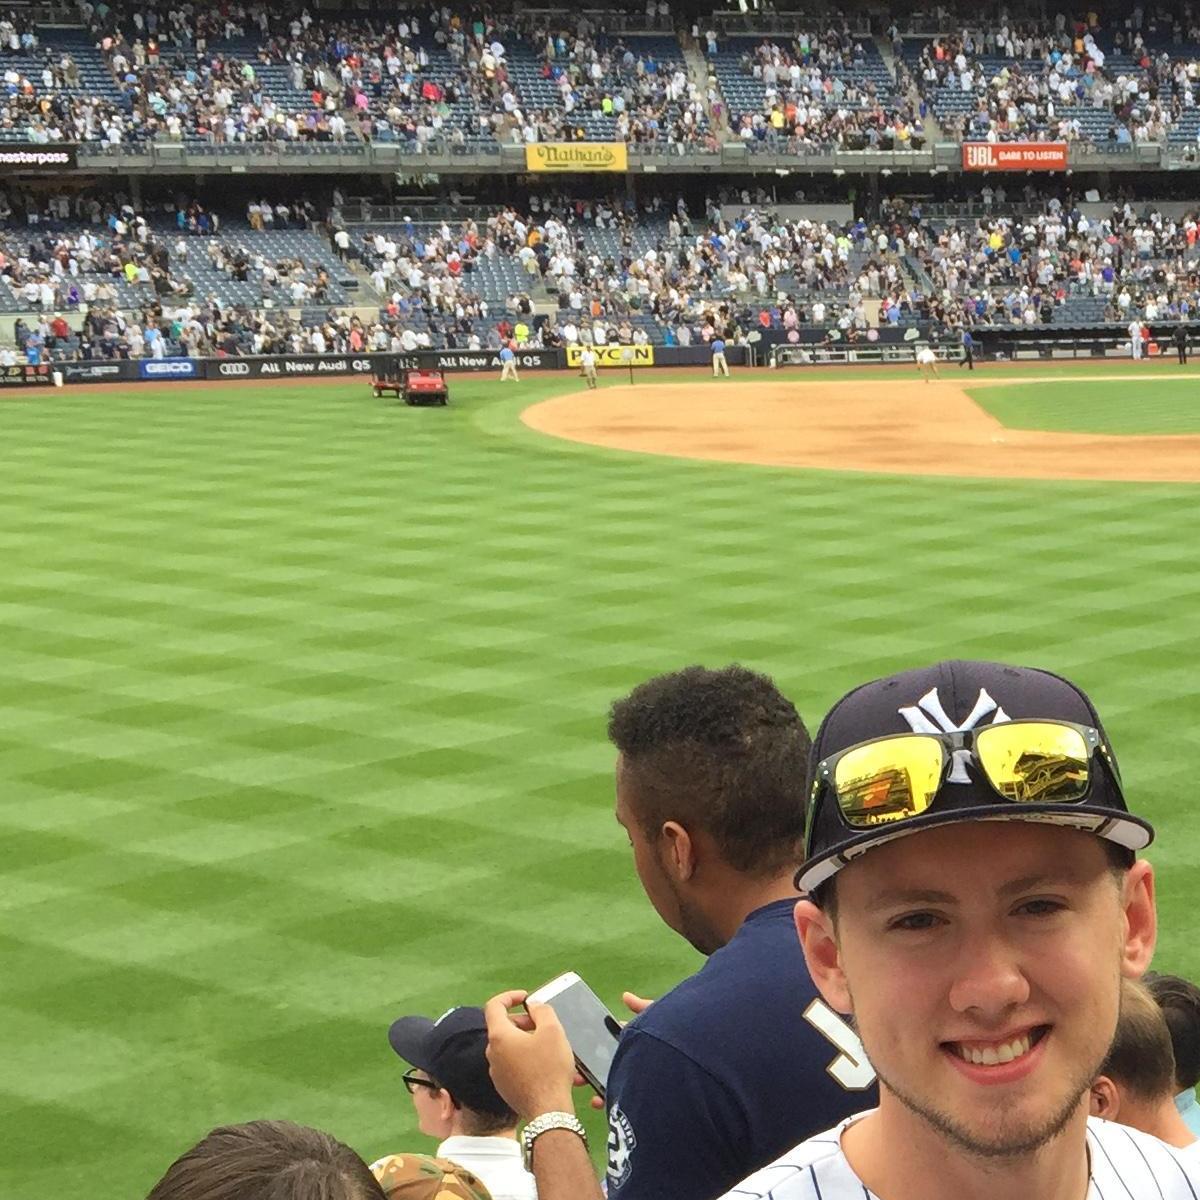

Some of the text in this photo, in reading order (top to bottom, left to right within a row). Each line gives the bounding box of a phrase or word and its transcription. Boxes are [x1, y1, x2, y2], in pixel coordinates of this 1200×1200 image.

[537, 145, 616, 165] Nathan's
[967, 146, 997, 166] JBL
[1022, 151, 1034, 161] TO
[1036, 151, 1064, 160] LISTEN
[571, 348, 649, 360] PYCN
[261, 360, 371, 373] All New Audi Q5
[438, 355, 541, 367] All New Ai Q5
[145, 362, 193, 373] GEICO
